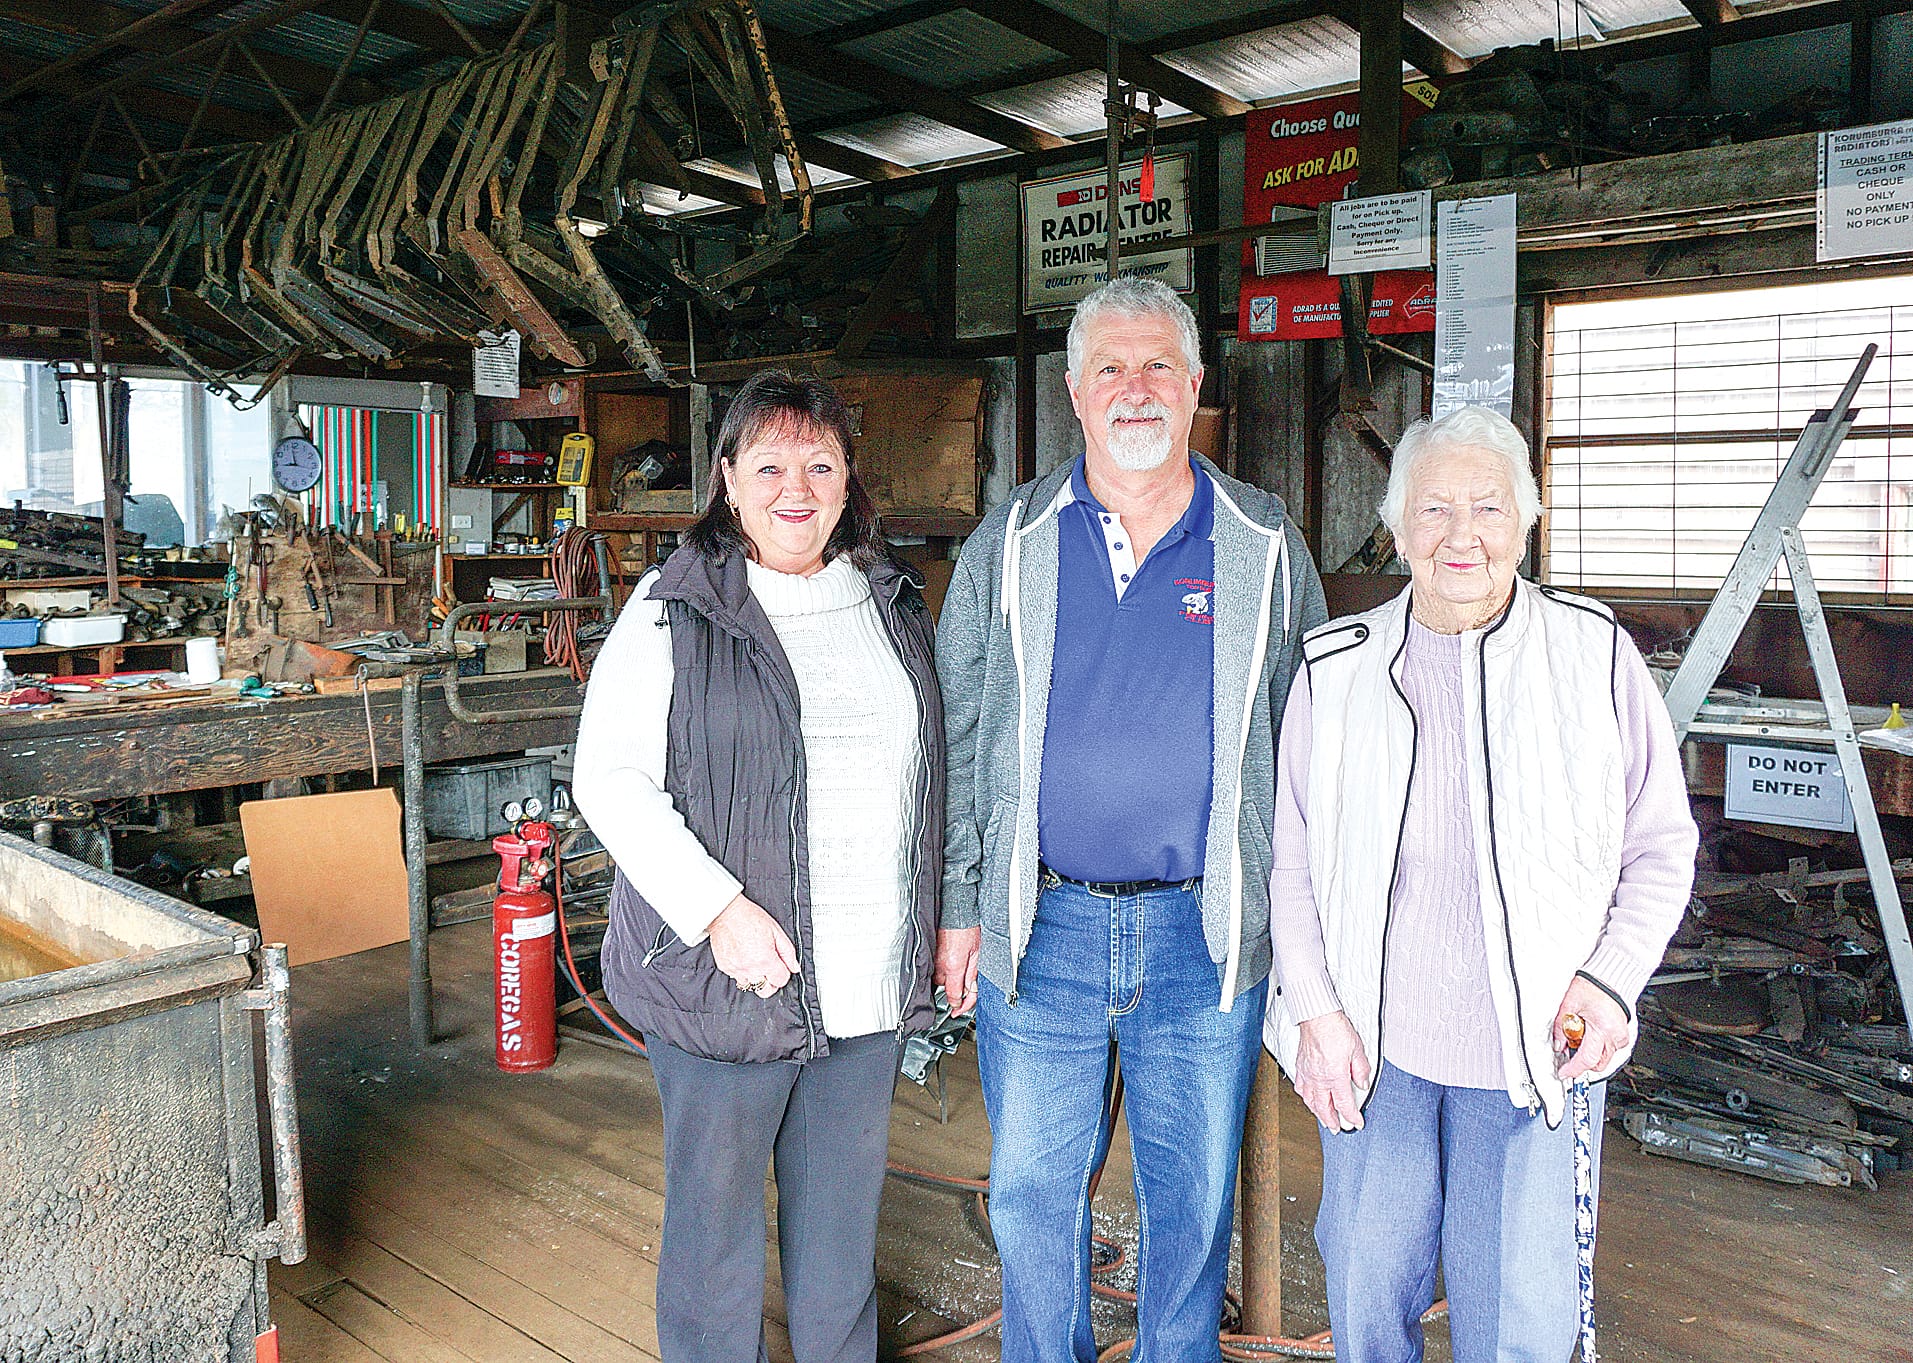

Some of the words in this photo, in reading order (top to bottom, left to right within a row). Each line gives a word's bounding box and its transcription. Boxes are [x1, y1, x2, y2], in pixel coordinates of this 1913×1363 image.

[1270, 118, 1327, 138] Choose
[1834, 126, 1904, 142] KORUMBURRA
[1834, 139, 1890, 152] RADIATORS
[1840, 154, 1886, 166] TRADING
[1262, 166, 1294, 190] ASK
[1296, 157, 1325, 180] FOR
[1326, 146, 1360, 175] AD
[1856, 165, 1887, 176] CASH
[1890, 164, 1906, 172] OR
[1095, 178, 1141, 201] DNS
[1858, 176, 1904, 190] CHEQUE
[1866, 190, 1896, 201] ONLY
[1350, 203, 1366, 212] jobs
[1401, 196, 1417, 205] paid
[1846, 208, 1862, 216] NO
[1847, 221, 1862, 229] NO
[1866, 217, 1891, 227] PICK
[1894, 215, 1909, 224] UP
[1352, 231, 1382, 239] Payment
[1042, 242, 1098, 268] REPAIR
[1354, 246, 1400, 255] Inconvenience
[1045, 274, 1088, 290] QUALITY
[1292, 304, 1314, 313] ADRAD
[1372, 299, 1393, 308] EDITED
[1303, 313, 1341, 322] MANUFACTU
[1370, 310, 1390, 318] PPLIER
[1748, 756, 1776, 770] DO
[1784, 759, 1827, 775] NOT
[1752, 780, 1820, 798] ENTER
[500, 932, 522, 1051] COREGAS
